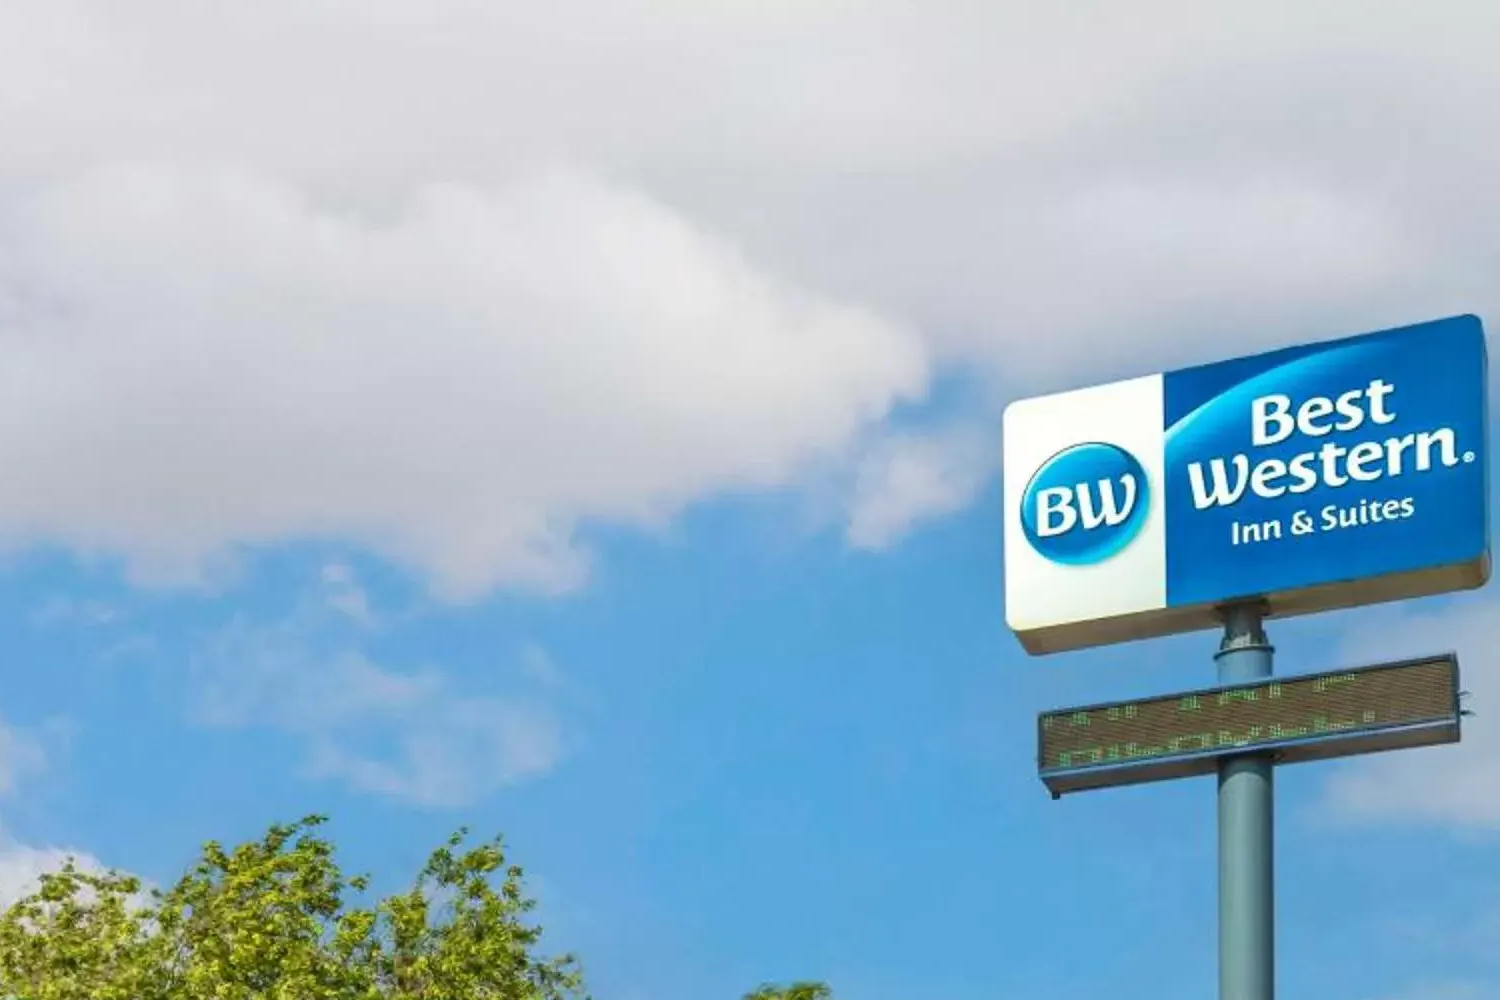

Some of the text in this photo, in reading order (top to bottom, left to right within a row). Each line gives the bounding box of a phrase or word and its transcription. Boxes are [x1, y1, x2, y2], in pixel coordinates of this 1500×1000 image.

[1251, 379, 1397, 447] Best
[1035, 473, 1137, 537] BW
[1231, 497, 1415, 545] Inn & Suites
